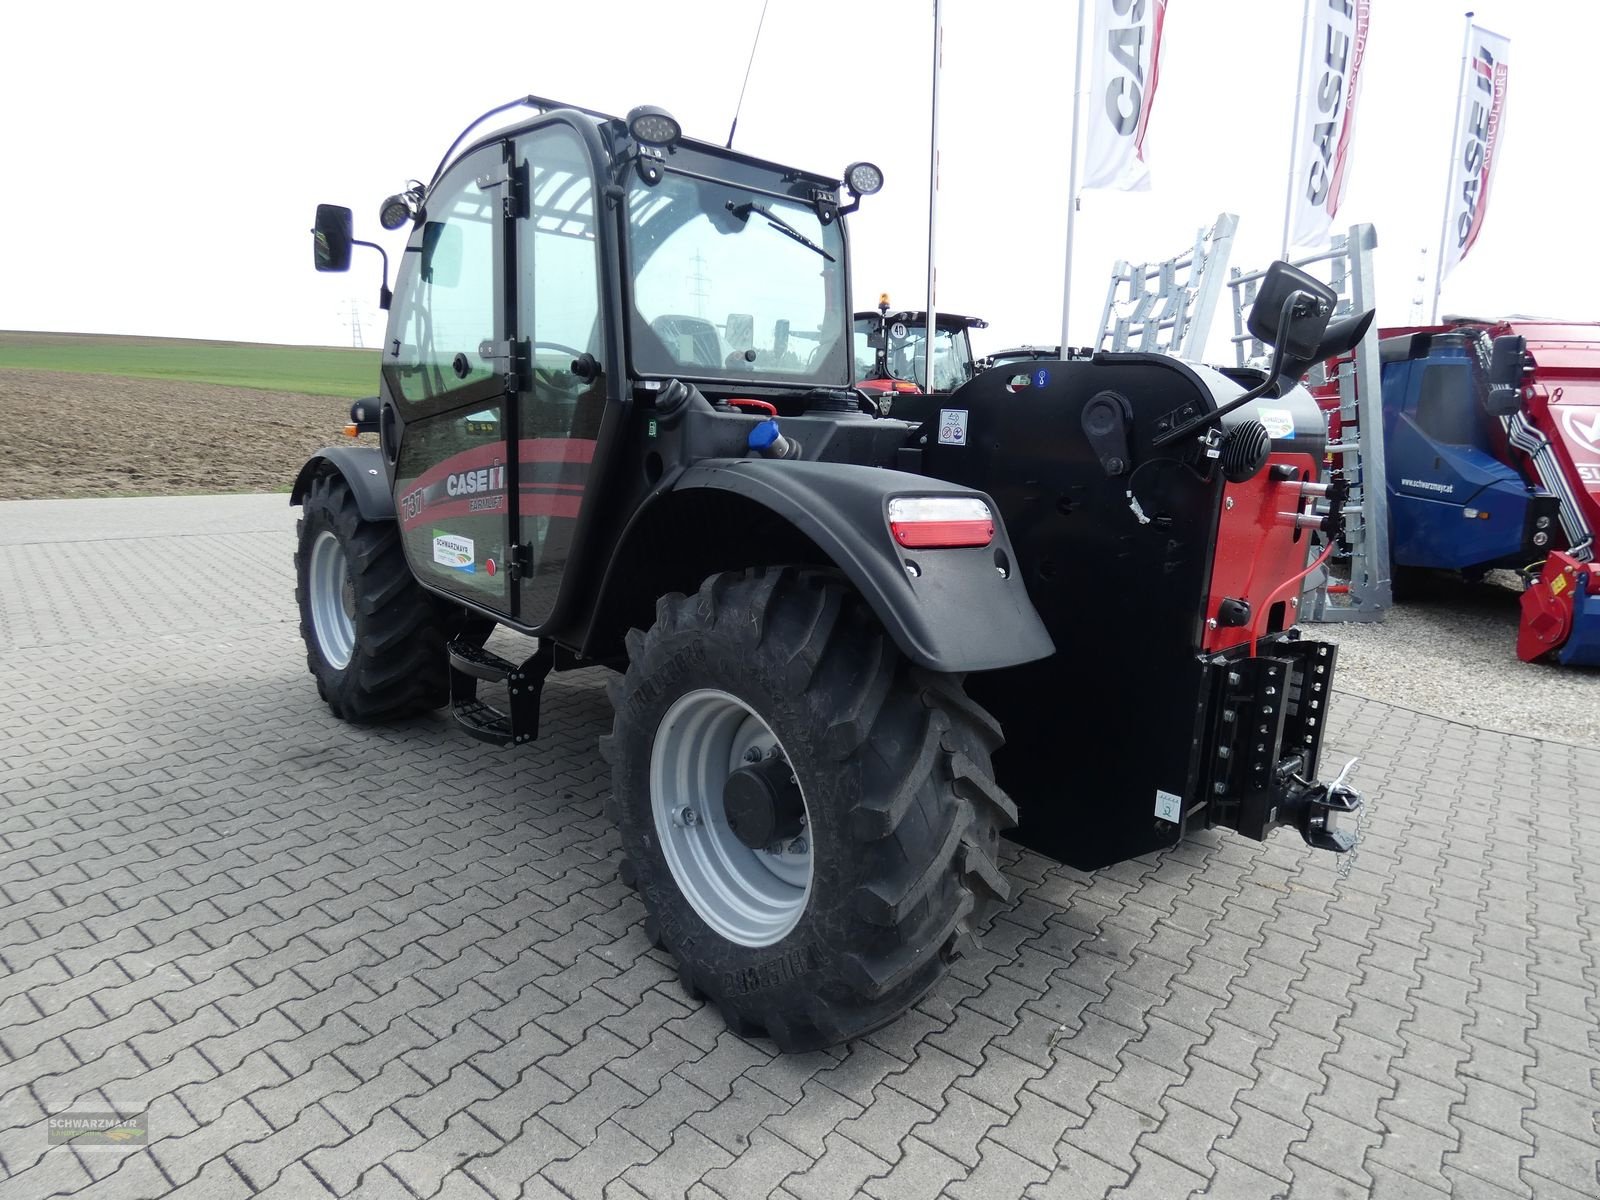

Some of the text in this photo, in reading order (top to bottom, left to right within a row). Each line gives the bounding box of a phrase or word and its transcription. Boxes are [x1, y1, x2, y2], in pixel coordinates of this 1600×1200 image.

[1306, 24, 1349, 206] CASE
[1482, 67, 1507, 170] AGRICULTURE
[1458, 100, 1489, 248] CASE
[894, 325, 904, 336] 40
[446, 470, 487, 496] CASE
[401, 487, 423, 522] 737
[469, 495, 503, 512] FARMLIFT
